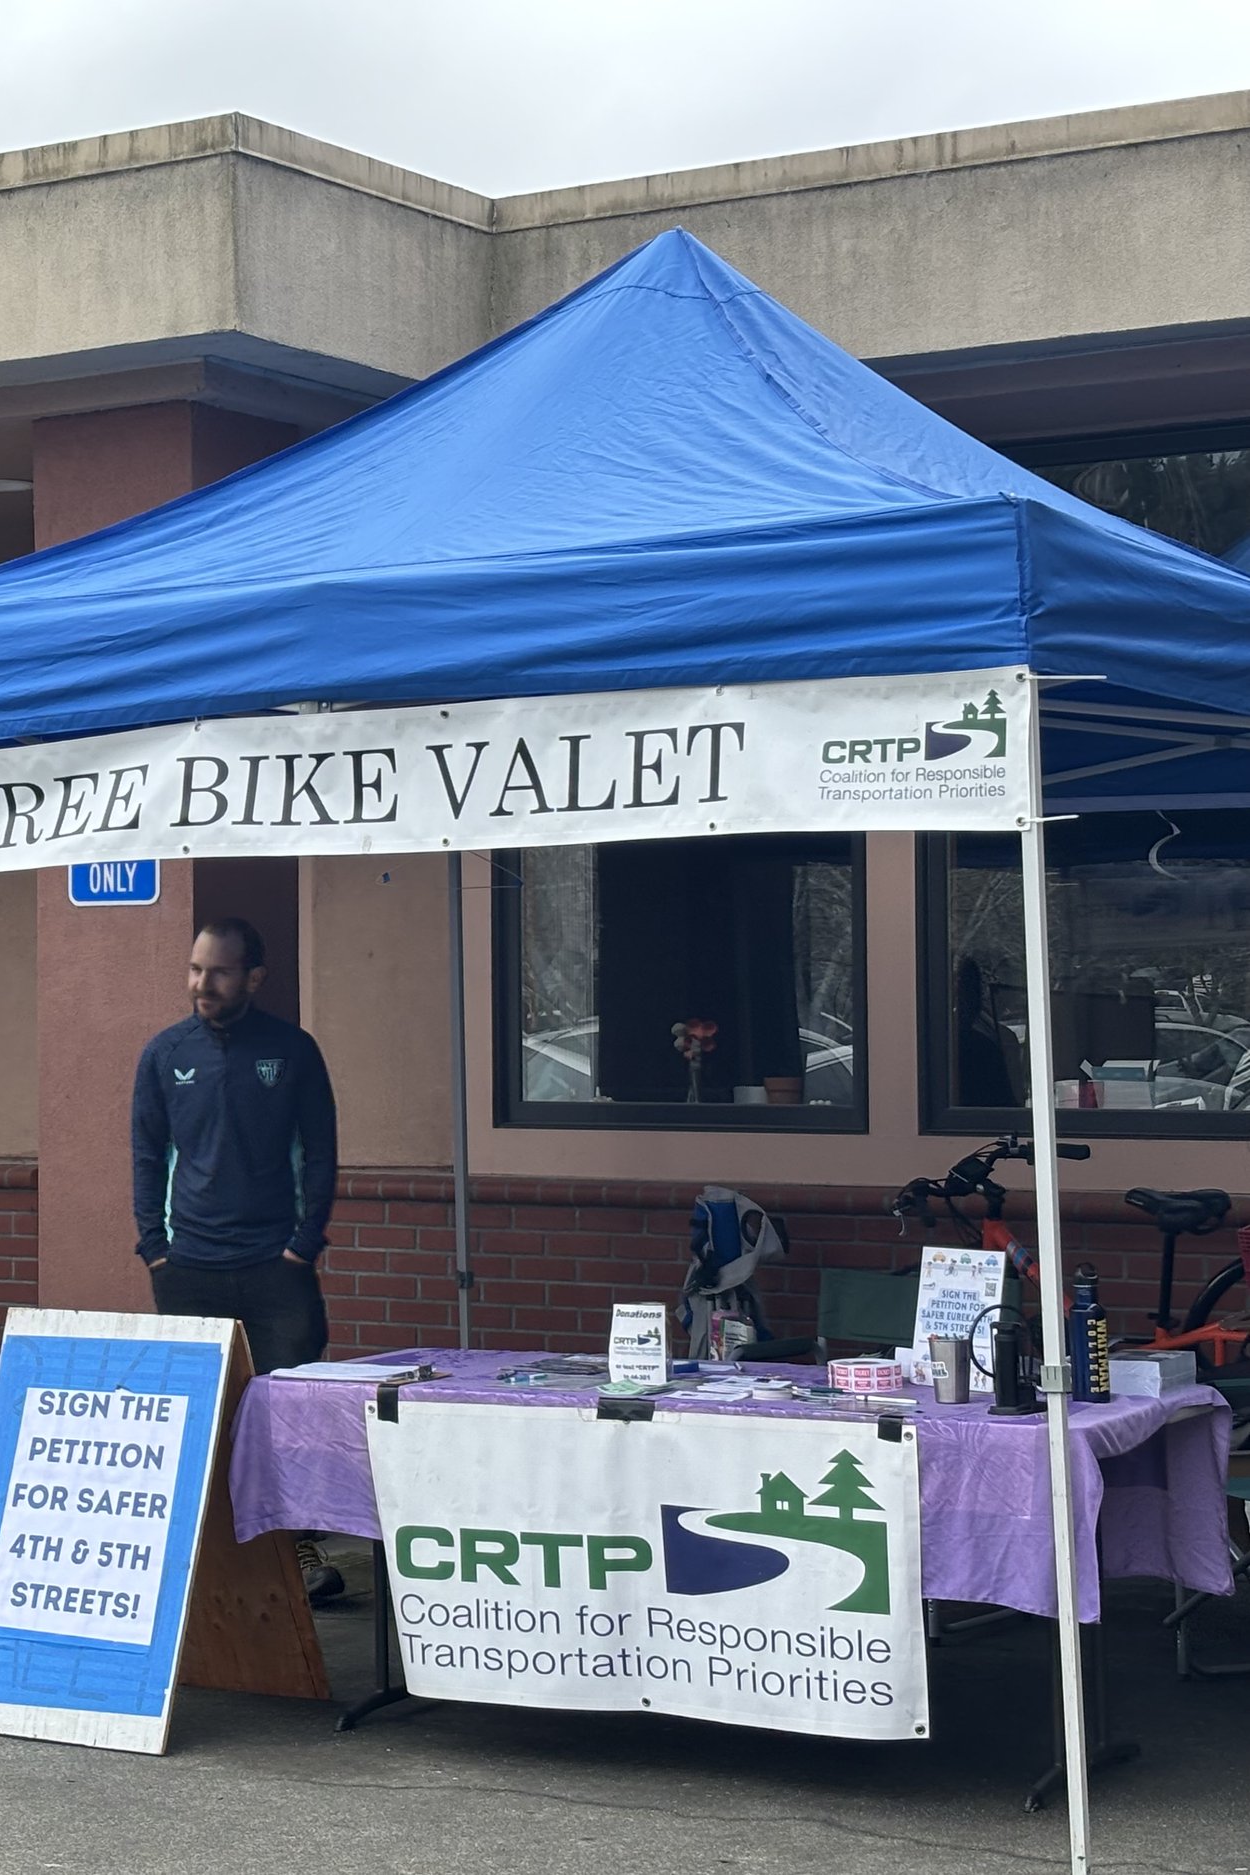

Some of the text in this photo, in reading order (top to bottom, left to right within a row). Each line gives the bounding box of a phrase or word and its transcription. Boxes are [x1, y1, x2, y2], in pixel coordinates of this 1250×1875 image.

[822, 737, 921, 764] CRTP
[168, 748, 400, 828] BIKE
[426, 721, 746, 820] VALET
[819, 764, 1006, 784] Coalition for Responsible
[818, 784, 1006, 803] Transportation Priorities
[90, 862, 138, 893] ONLY
[931, 1300, 967, 1311] PETITION
[941, 1290, 977, 1301] SIGN THE
[616, 1308, 662, 1319] Donations
[921, 1309, 944, 1320] SAFER
[933, 1322, 948, 1331] 5TH
[950, 1323, 985, 1335] STREES!
[613, 1337, 637, 1345] CRTP
[1087, 1319, 1099, 1393] COLLEGE
[1097, 1318, 1109, 1392] WHITMAN
[38, 1390, 172, 1423] SIGN THE
[29, 1437, 164, 1470] PETITION
[11, 1483, 167, 1519] FOR SAFER
[9, 1533, 151, 1571] 4TH & 5TH
[395, 1525, 653, 1590] CRTP
[10, 1581, 140, 1620] STREETS!
[400, 1593, 892, 1664] Coalition for Responsible
[402, 1632, 894, 1706] Transportation Priorities
